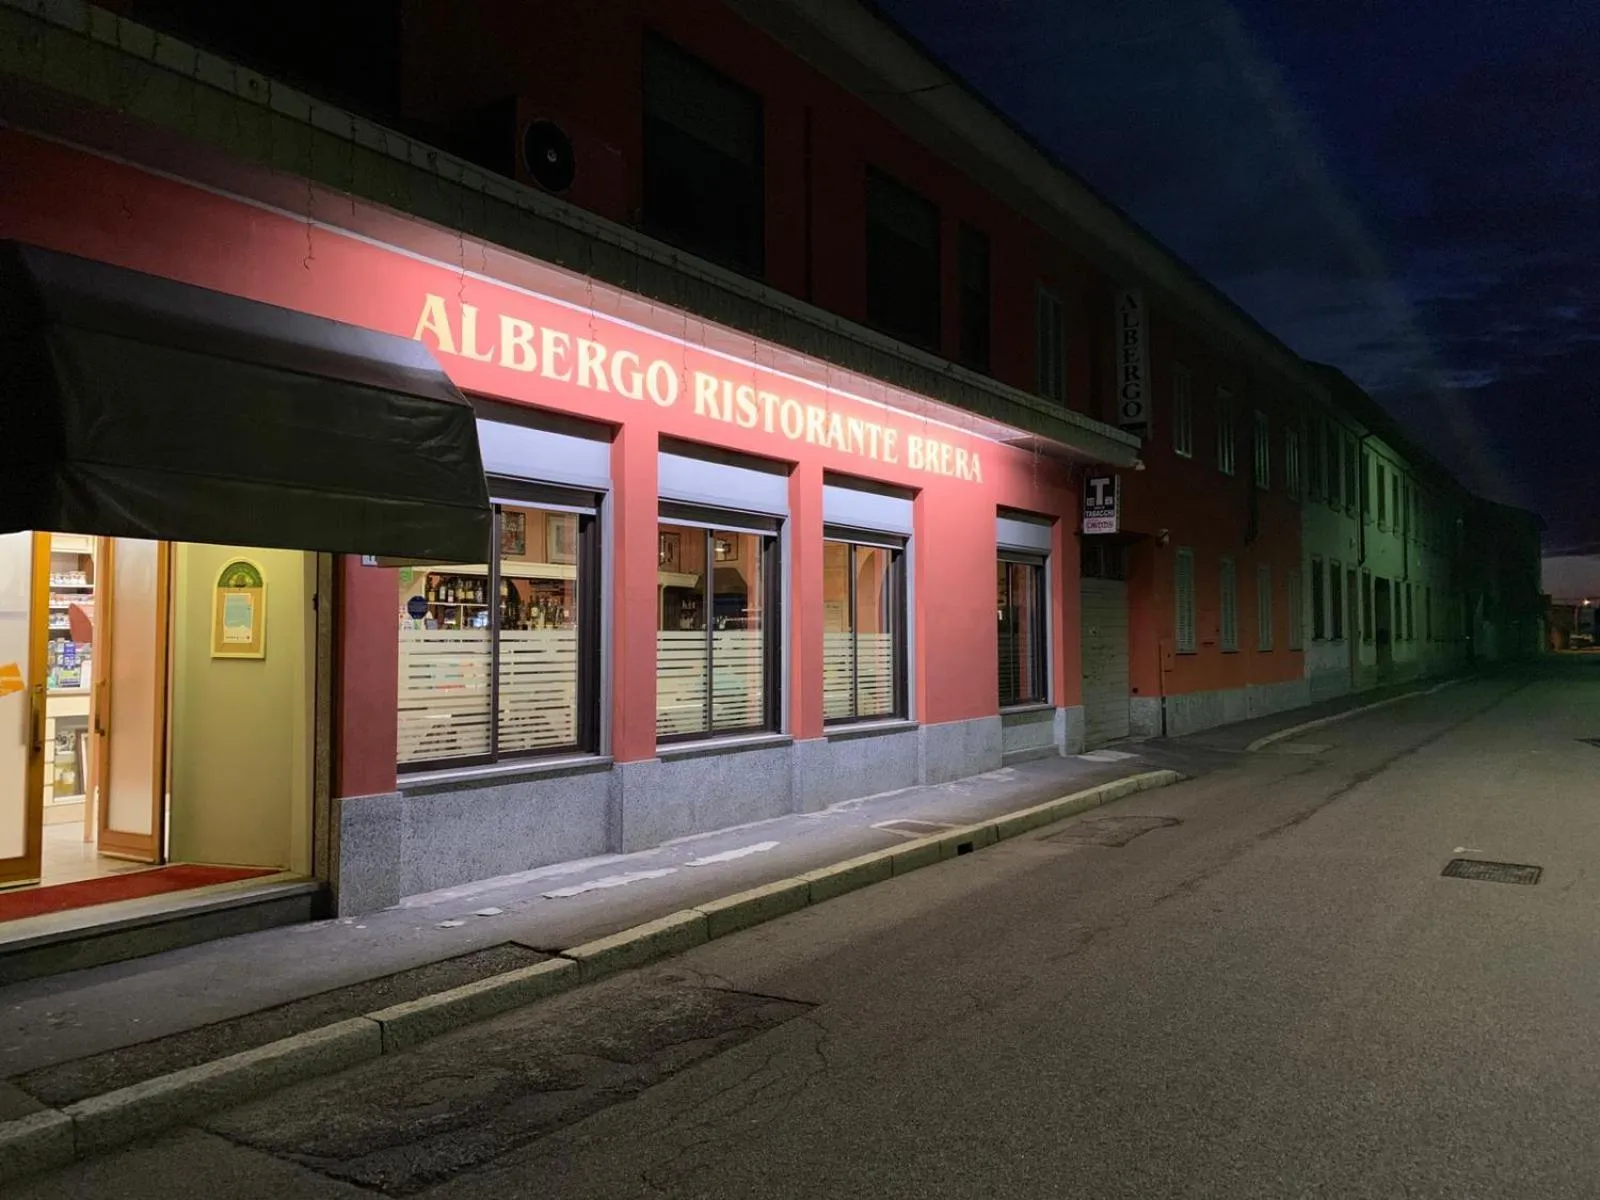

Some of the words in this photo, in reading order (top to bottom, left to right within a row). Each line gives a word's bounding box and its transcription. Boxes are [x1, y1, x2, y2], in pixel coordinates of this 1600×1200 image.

[414, 294, 678, 407] ALBERGO
[694, 371, 898, 464] RISTORANTE
[908, 436, 982, 483] BRERA
[1119, 294, 1142, 418] ALBERGO
